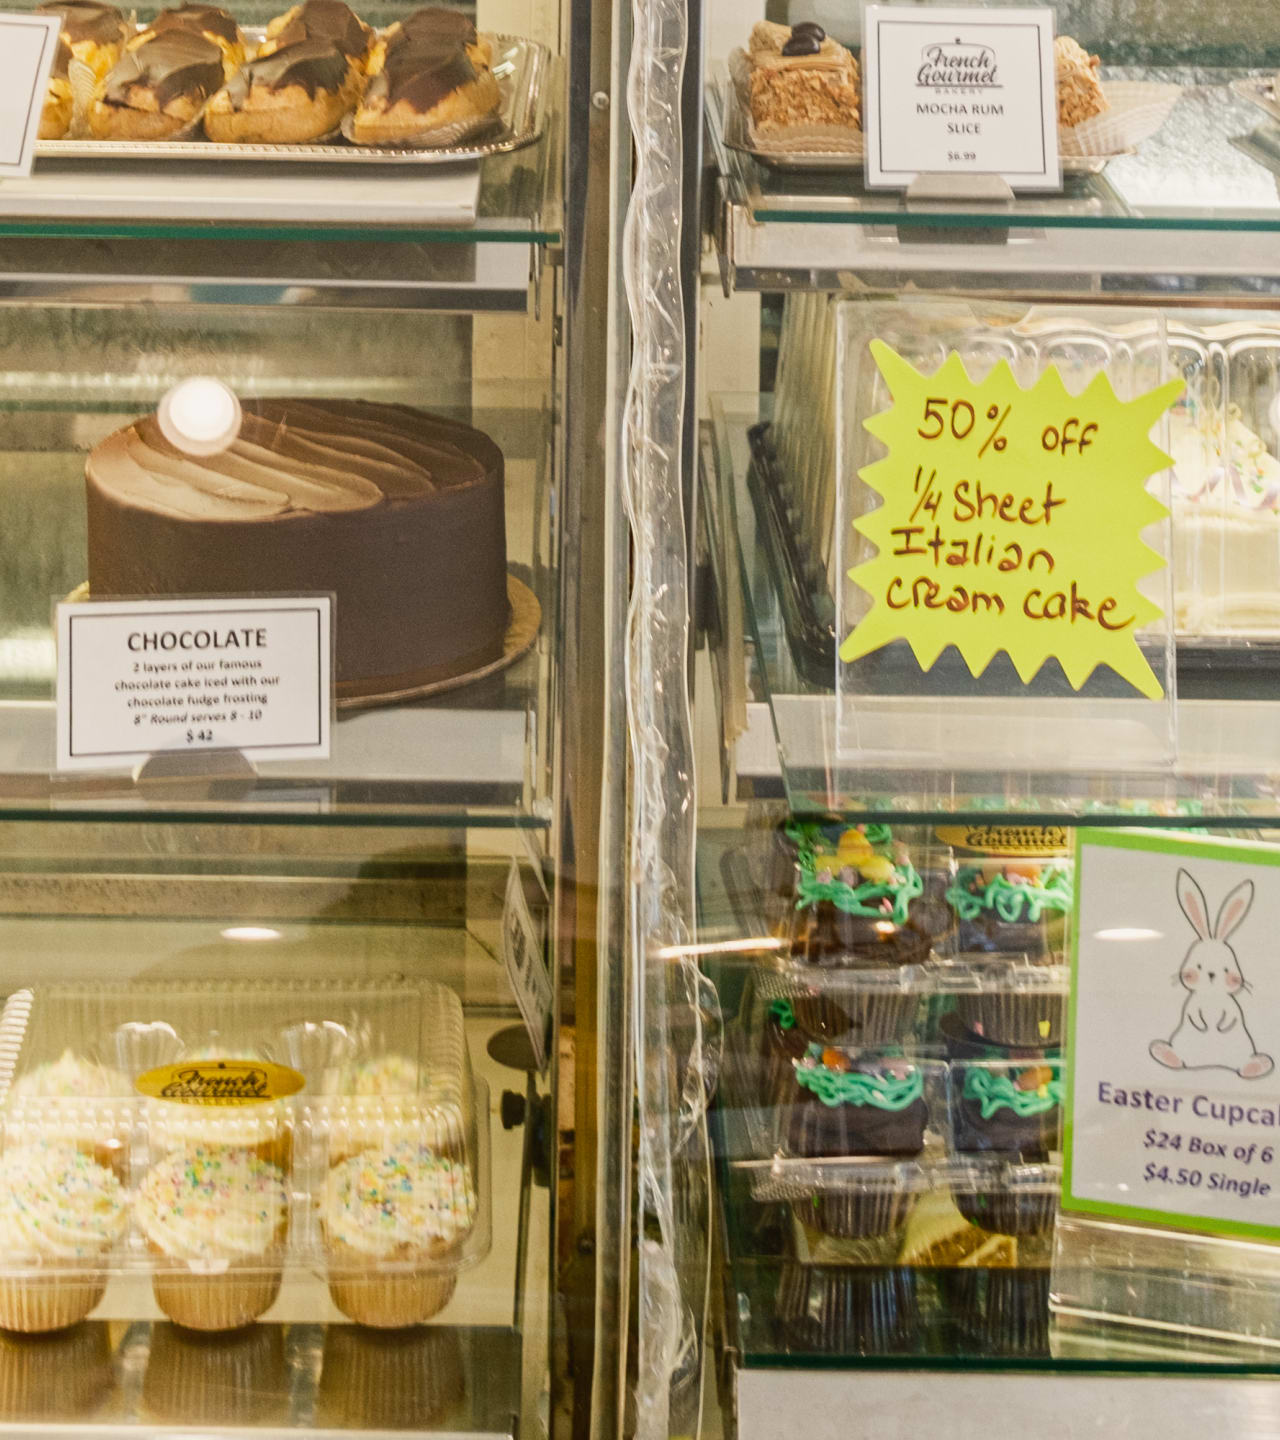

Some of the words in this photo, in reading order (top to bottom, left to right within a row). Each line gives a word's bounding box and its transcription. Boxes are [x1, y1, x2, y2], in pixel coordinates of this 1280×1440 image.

[927, 47, 989, 68] French
[917, 64, 997, 86] Gourmet
[916, 104, 967, 115] MOCHA
[972, 104, 1003, 115] RUM
[948, 123, 981, 134] SLICE
[948, 151, 976, 161] $6.99
[918, 398, 1011, 458] 50%
[890, 526, 1054, 574] Italian
[127, 629, 267, 652] CHOCOLATE
[197, 730, 213, 741] 42
[1097, 1081, 1182, 1117] Easter
[1143, 1129, 1181, 1151] $24
[1188, 1136, 1225, 1158] Box
[1234, 1140, 1257, 1165] of
[1261, 1145, 1274, 1164] 6
[1144, 1163, 1202, 1188] $4.50
[1207, 1170, 1271, 1197] Single
